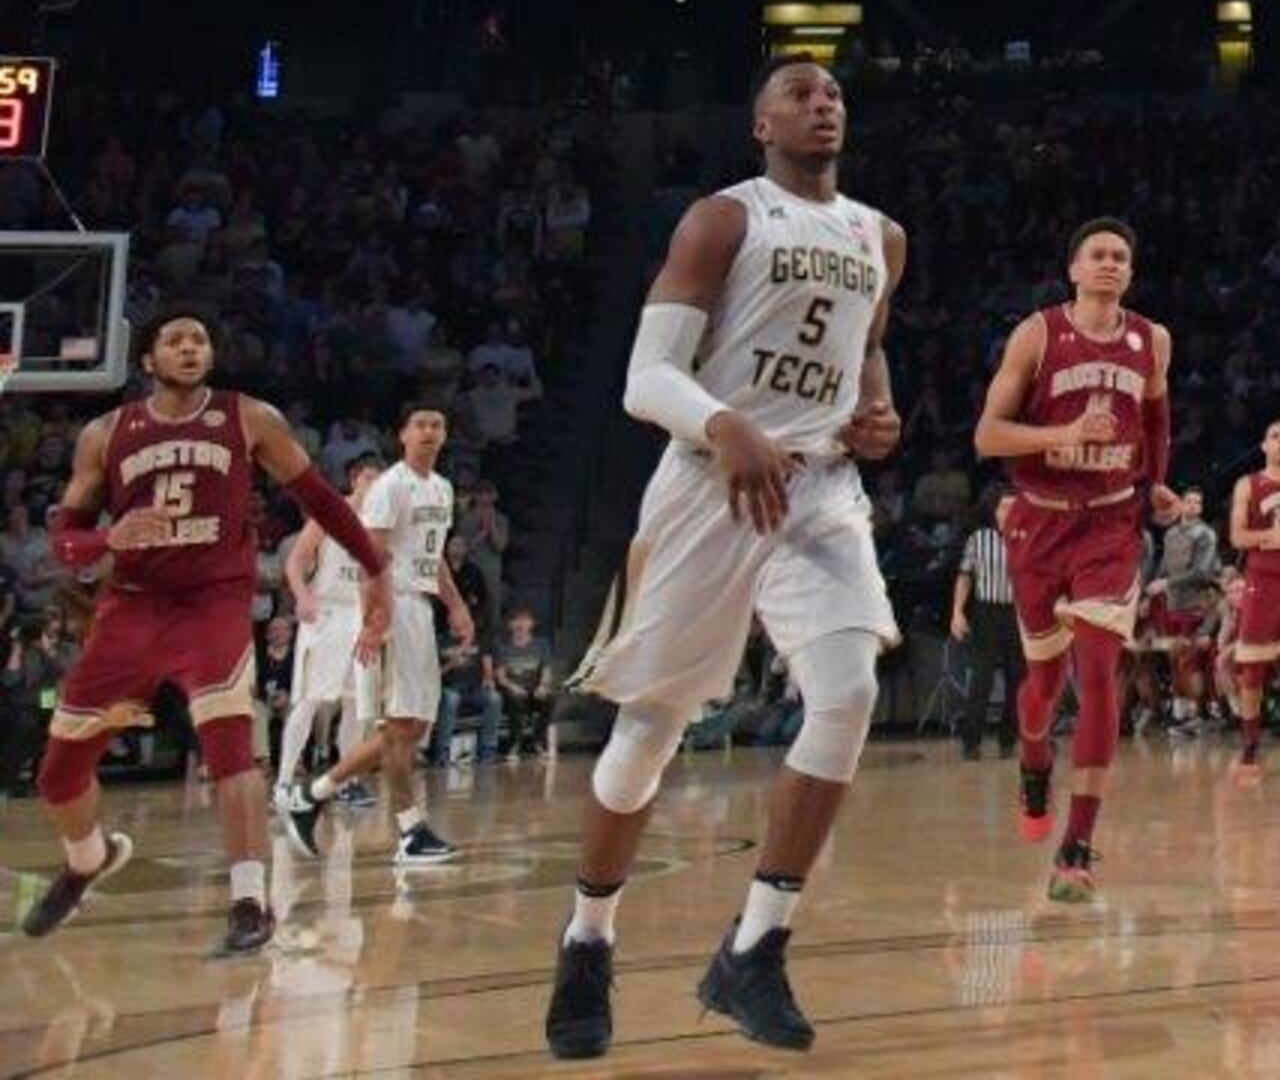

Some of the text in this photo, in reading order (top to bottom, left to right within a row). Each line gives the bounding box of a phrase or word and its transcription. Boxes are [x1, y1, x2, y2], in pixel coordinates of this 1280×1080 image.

[771, 246, 878, 297] GEORGIA
[798, 296, 835, 347] 5
[752, 348, 844, 406] TECH
[153, 471, 196, 518] 15
